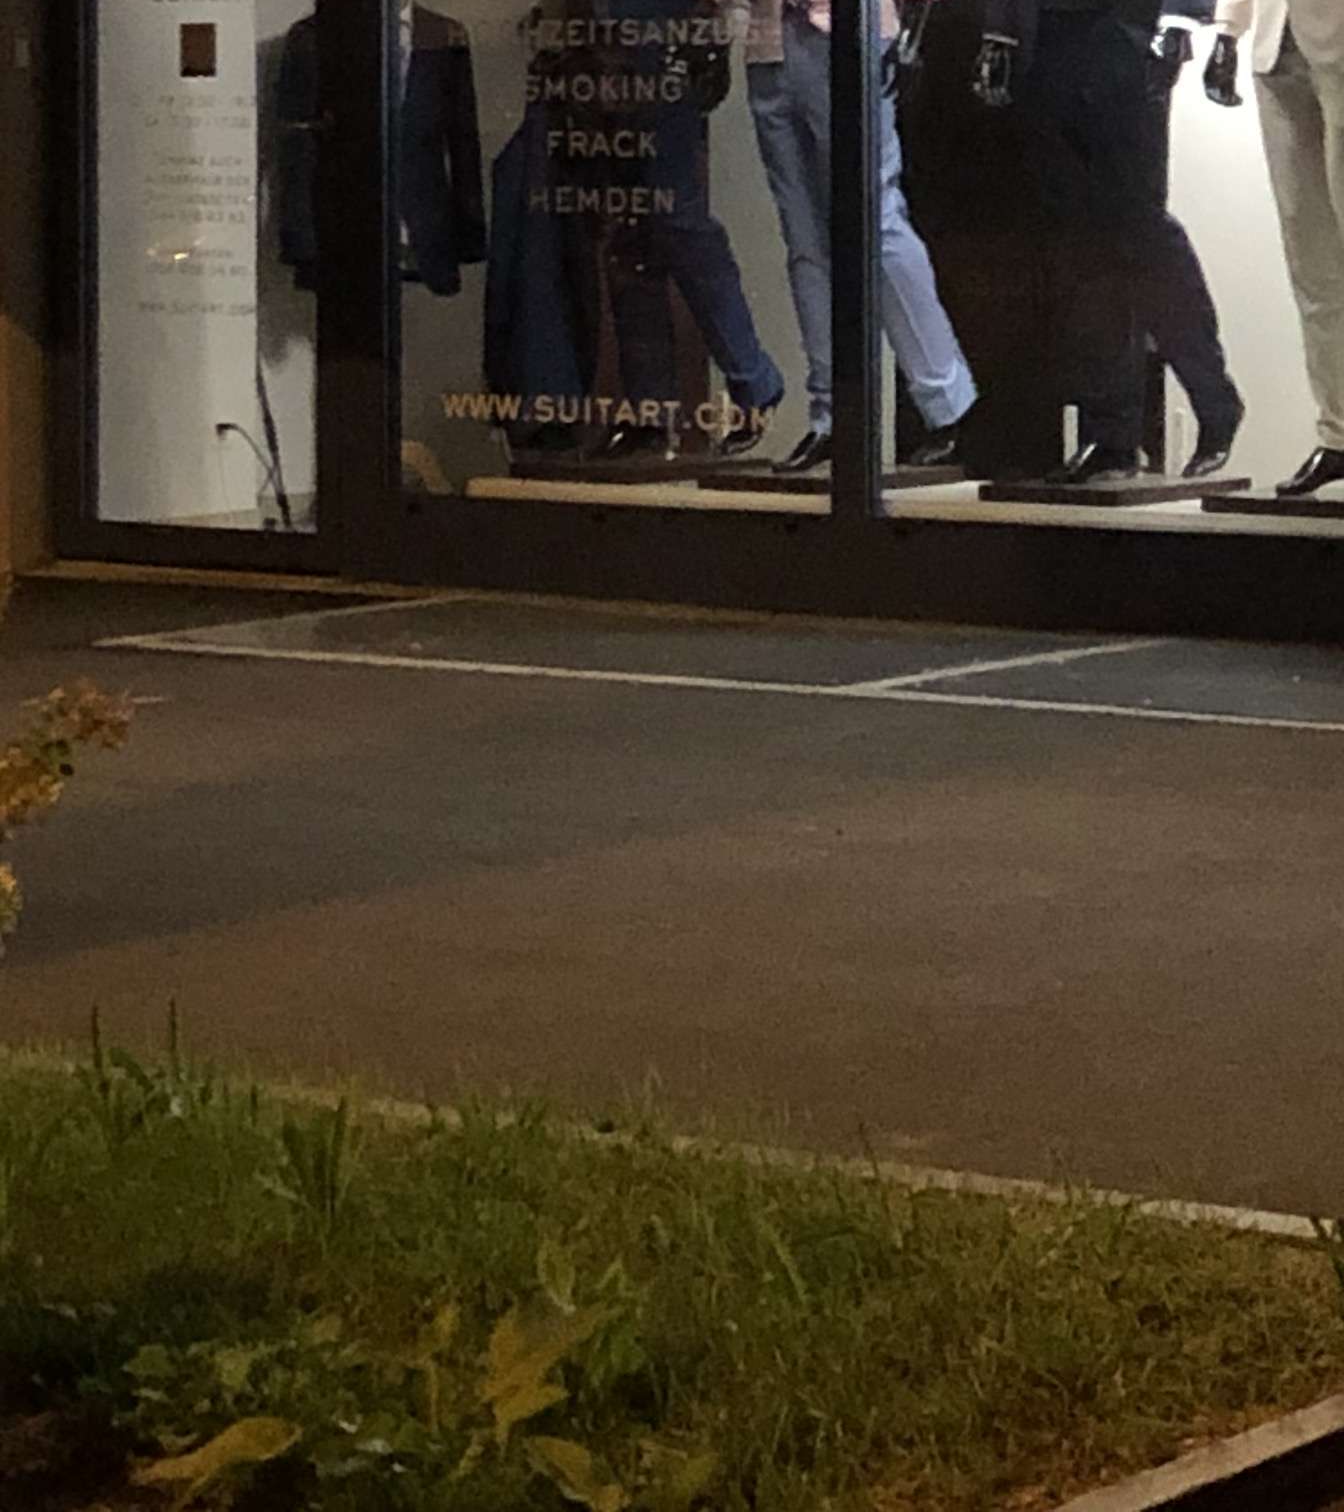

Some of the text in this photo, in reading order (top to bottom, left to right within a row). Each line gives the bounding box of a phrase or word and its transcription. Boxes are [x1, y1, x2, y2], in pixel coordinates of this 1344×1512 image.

[525, 74, 684, 103] SMOKING
[546, 130, 658, 159] FRACK
[528, 185, 676, 215] HEMDEN
[443, 392, 776, 433] WWW.SUITART.COM
